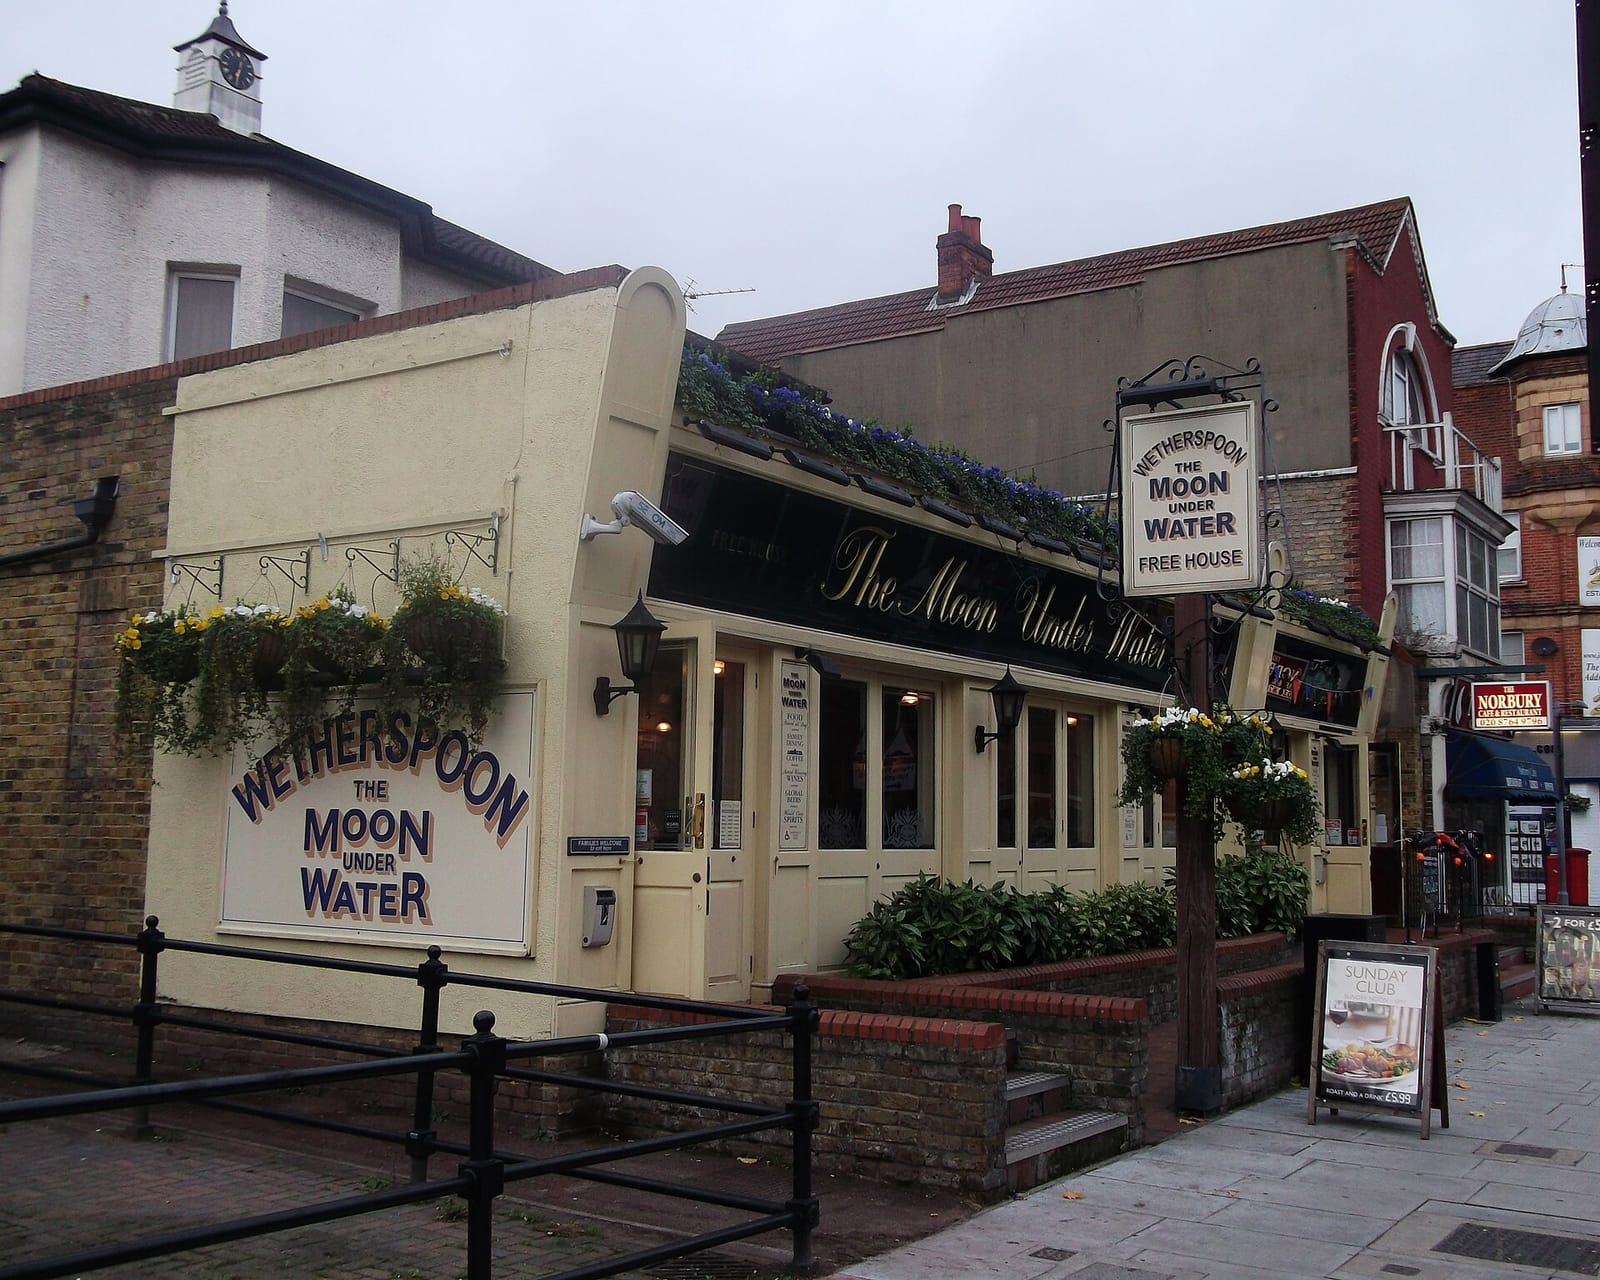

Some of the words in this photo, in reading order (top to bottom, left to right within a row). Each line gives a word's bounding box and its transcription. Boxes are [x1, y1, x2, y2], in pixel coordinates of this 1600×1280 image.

[1133, 430, 1248, 477] WETHERSPOON
[1175, 461, 1201, 473] THE
[1150, 470, 1228, 499] MOON
[1169, 500, 1214, 514] UNDER
[1144, 512, 1234, 540] WATER
[1139, 554, 1180, 572] FREE
[1185, 550, 1242, 569] HOUSE
[821, 526, 896, 612] The
[898, 556, 998, 633] Moon
[1015, 576, 1095, 654] Under
[1105, 603, 1167, 669] Water
[1586, 662, 1599, 671] The
[783, 678, 806, 690] MOON
[782, 696, 807, 710] WATER
[1478, 693, 1542, 709] NORBURY
[1480, 718, 1496, 726] 020
[232, 709, 530, 838] WETHERSPOON
[353, 780, 387, 798] THE
[304, 808, 430, 856] MOON
[343, 852, 395, 871] UNDER
[300, 866, 426, 919] WATER
[1553, 917, 1562, 929] 2
[1564, 919, 1586, 928] FOR
[1345, 966, 1408, 983] SUNDAY
[1356, 980, 1396, 996] CLUB
[1326, 1087, 1344, 1095] ROAST
[1344, 1089, 1358, 1098] AND
[1385, 1092, 1411, 1105] £5.99
